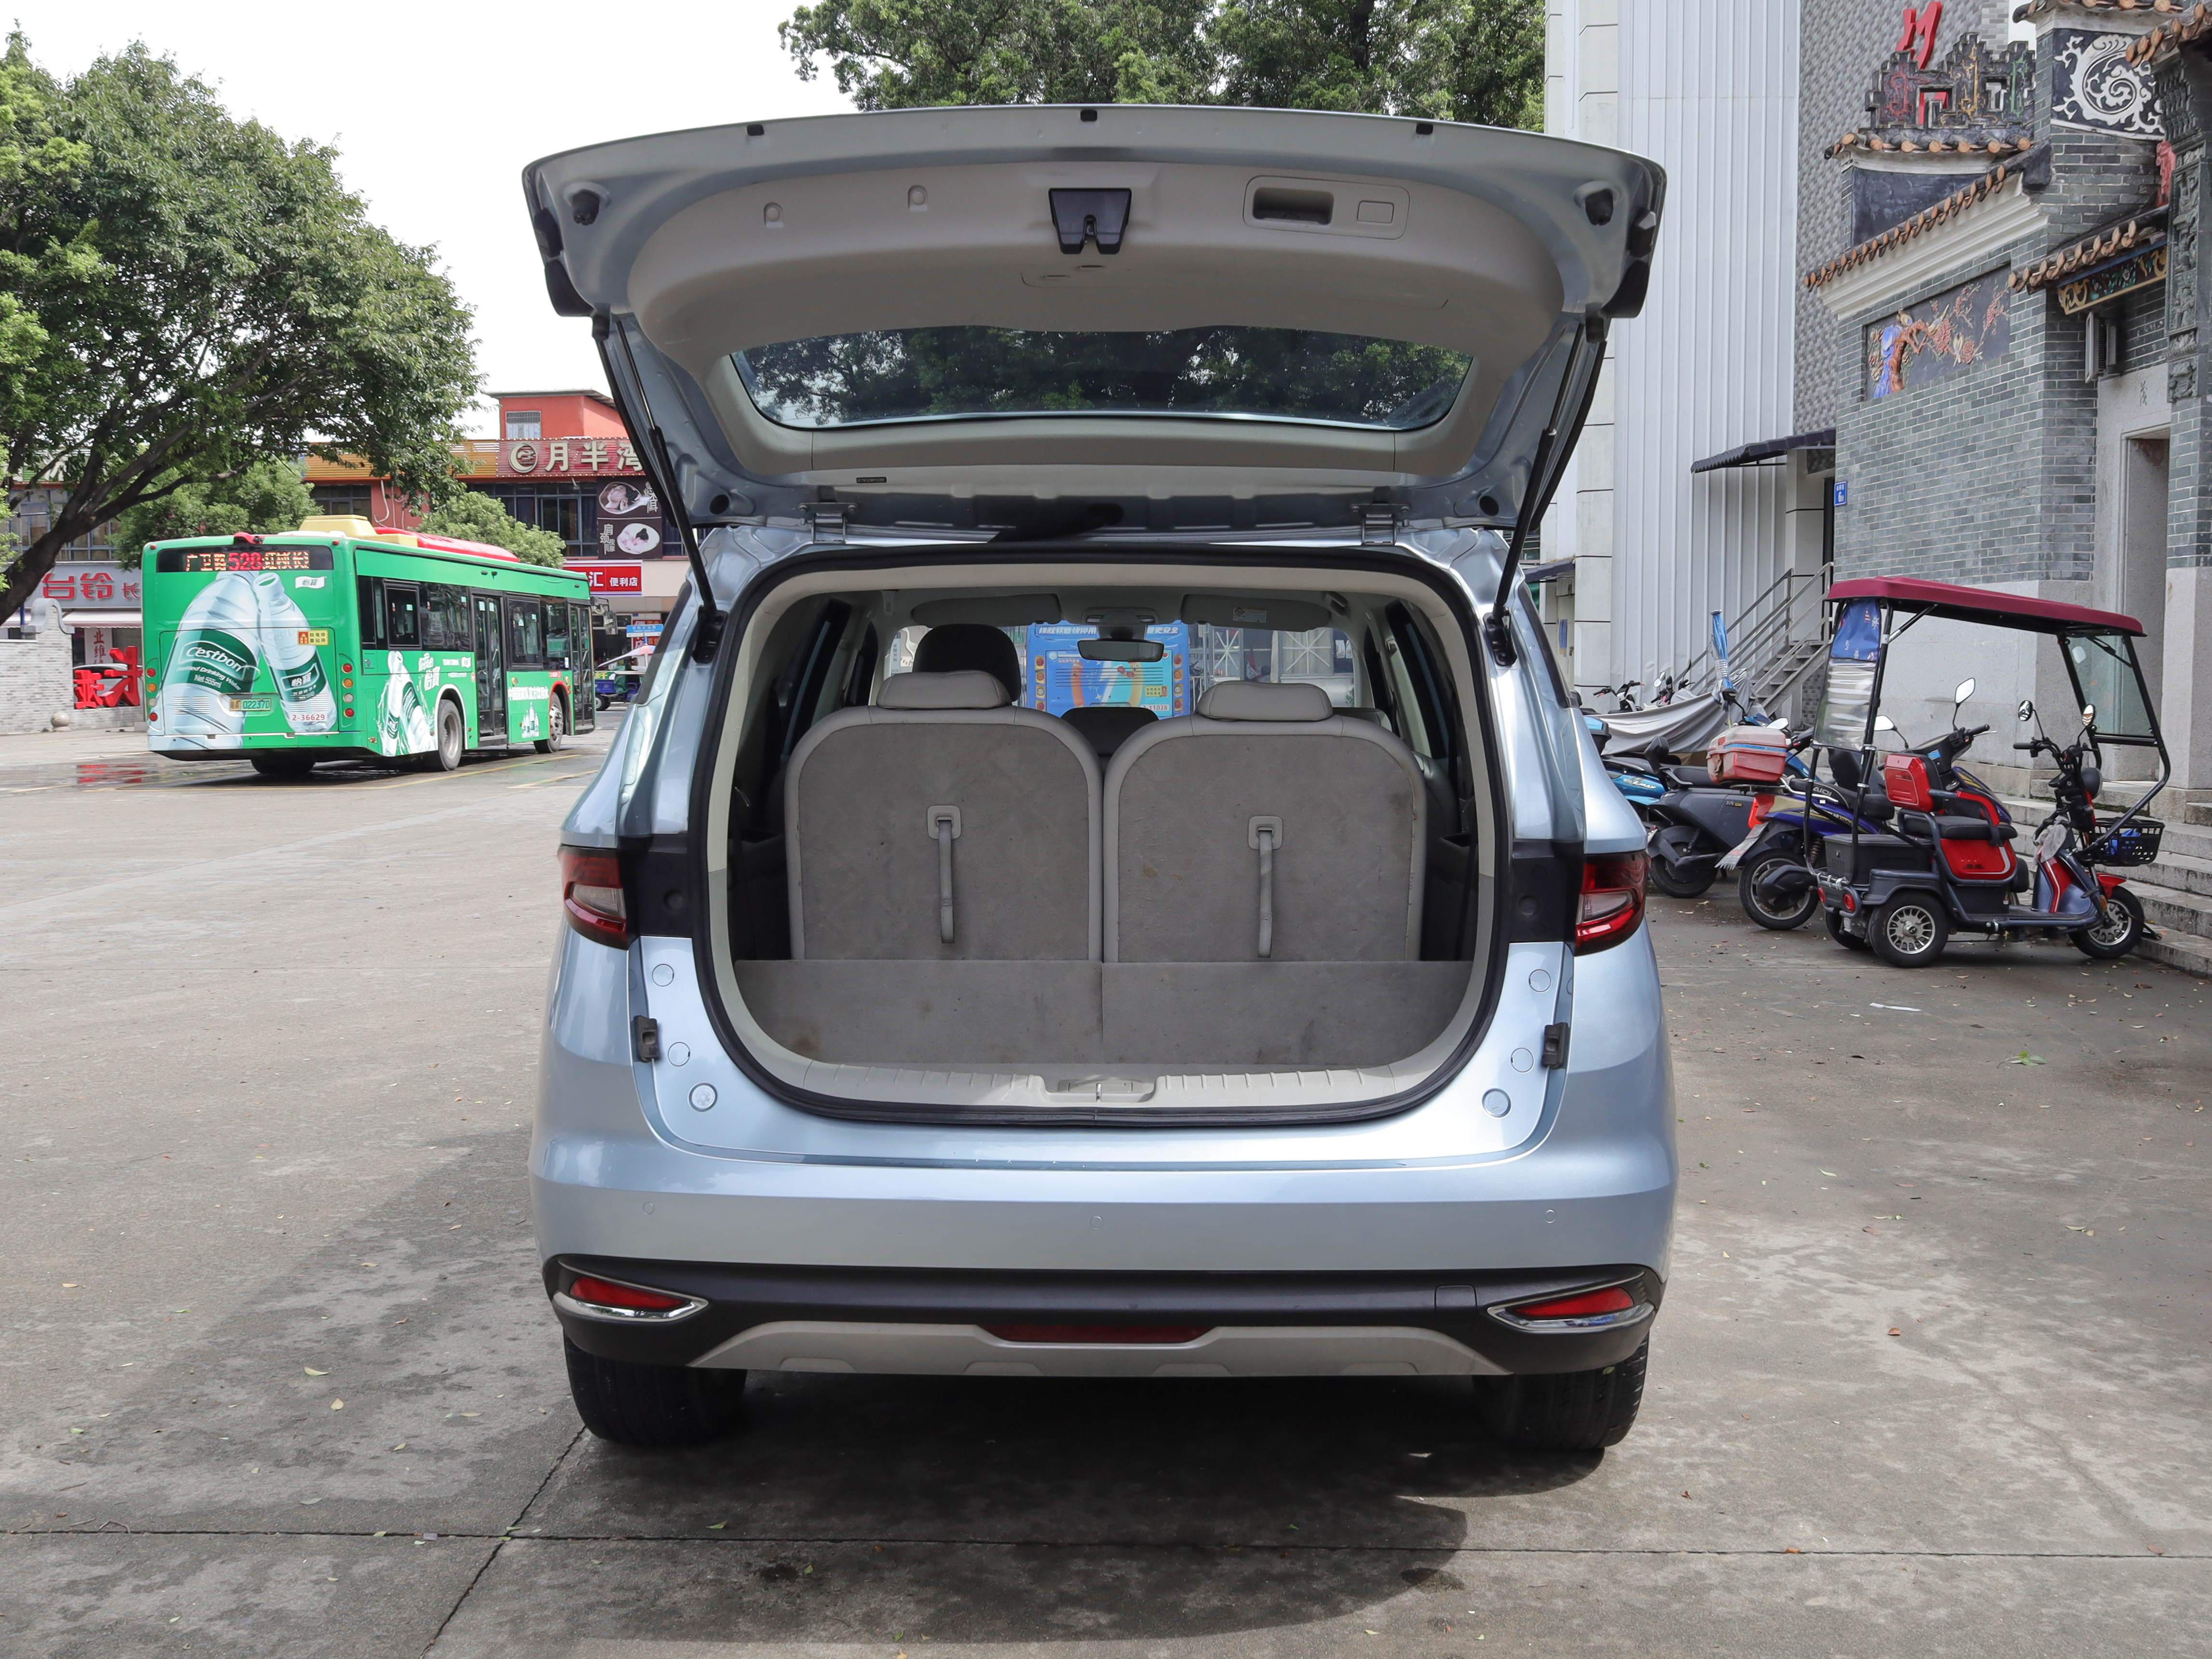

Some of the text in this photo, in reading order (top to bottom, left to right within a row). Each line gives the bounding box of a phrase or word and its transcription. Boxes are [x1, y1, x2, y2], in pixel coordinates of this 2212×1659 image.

[229, 552, 262, 571] 528
[42, 572, 114, 599] 台铃
[580, 571, 604, 587] 汇
[609, 577, 638, 586] 便利店
[94, 628, 107, 664] 业维
[226, 677, 242, 691] Water
